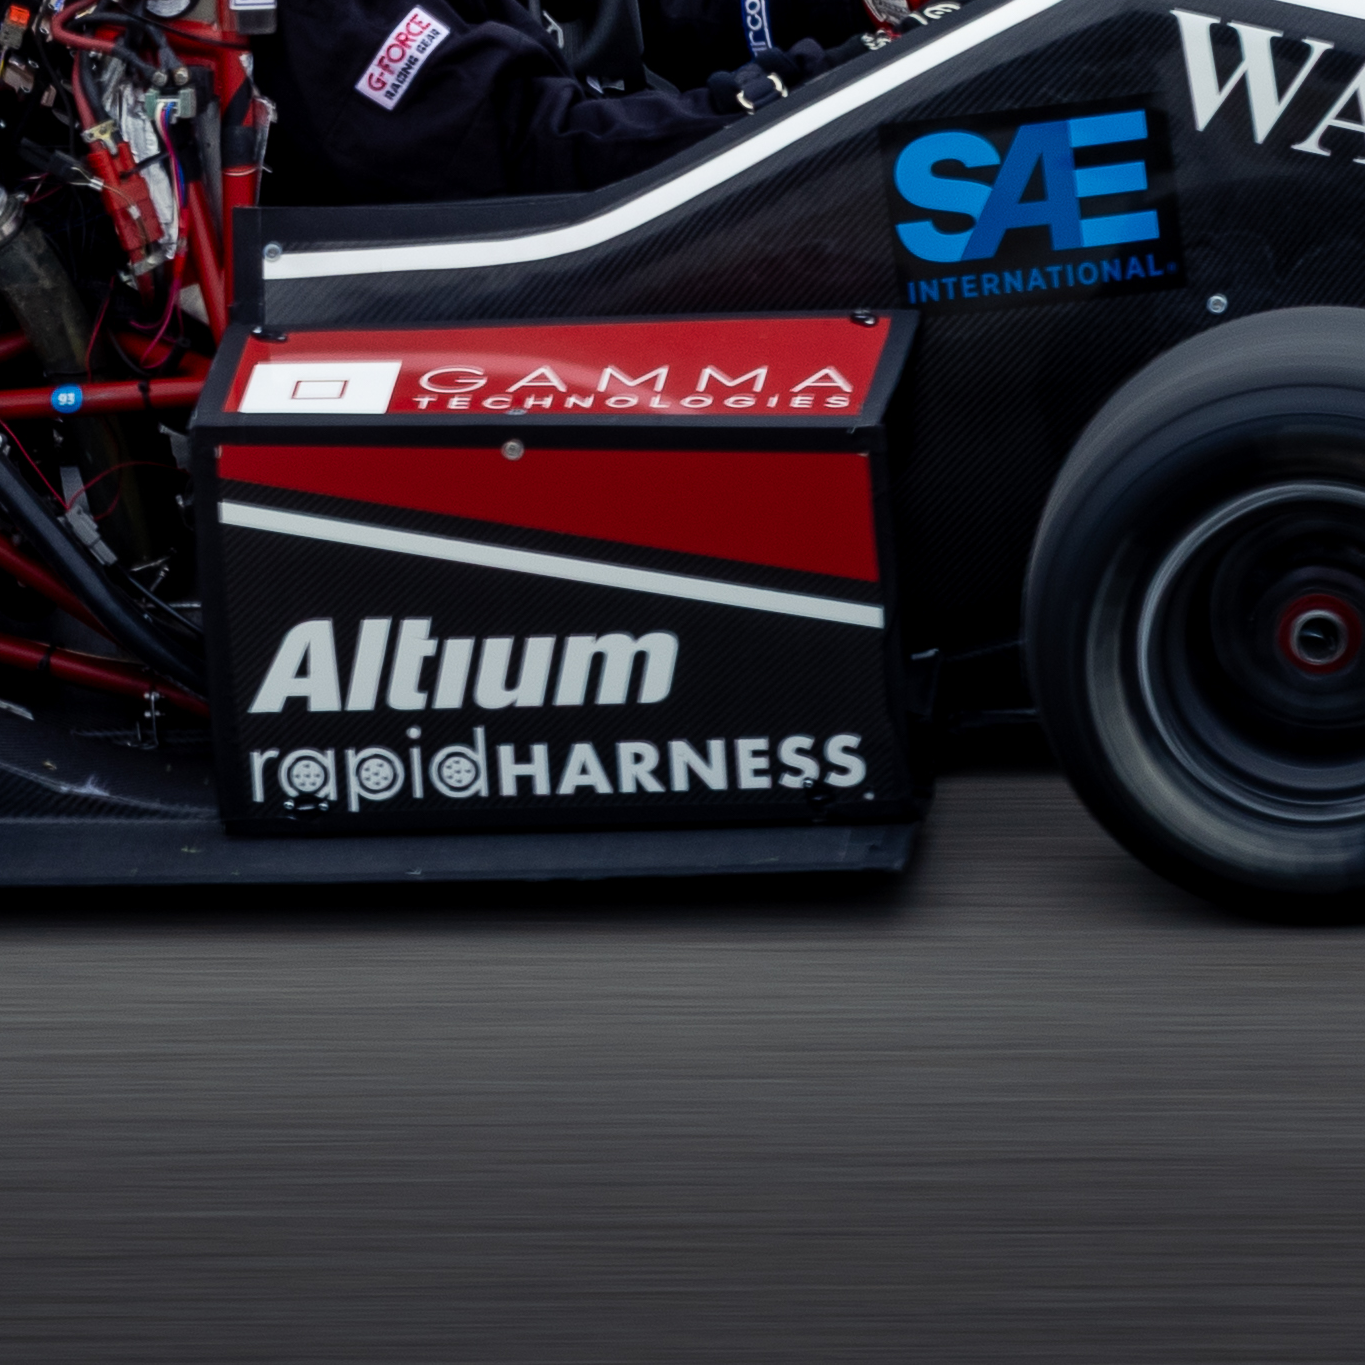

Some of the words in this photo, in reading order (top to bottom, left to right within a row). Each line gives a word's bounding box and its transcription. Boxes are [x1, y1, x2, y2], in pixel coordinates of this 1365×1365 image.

[367, 13, 432, 92] G-FORCE
[384, 55, 420, 101] RACING
[415, 28, 441, 55] GEAR
[894, 110, 1161, 264] SAE
[906, 253, 1165, 306] INTERNATIONAL
[411, 393, 851, 410] TECHNOLOGIES
[417, 364, 854, 395] GAMMA
[246, 616, 680, 715] Altium
[249, 725, 868, 813] rapidHARNESS
